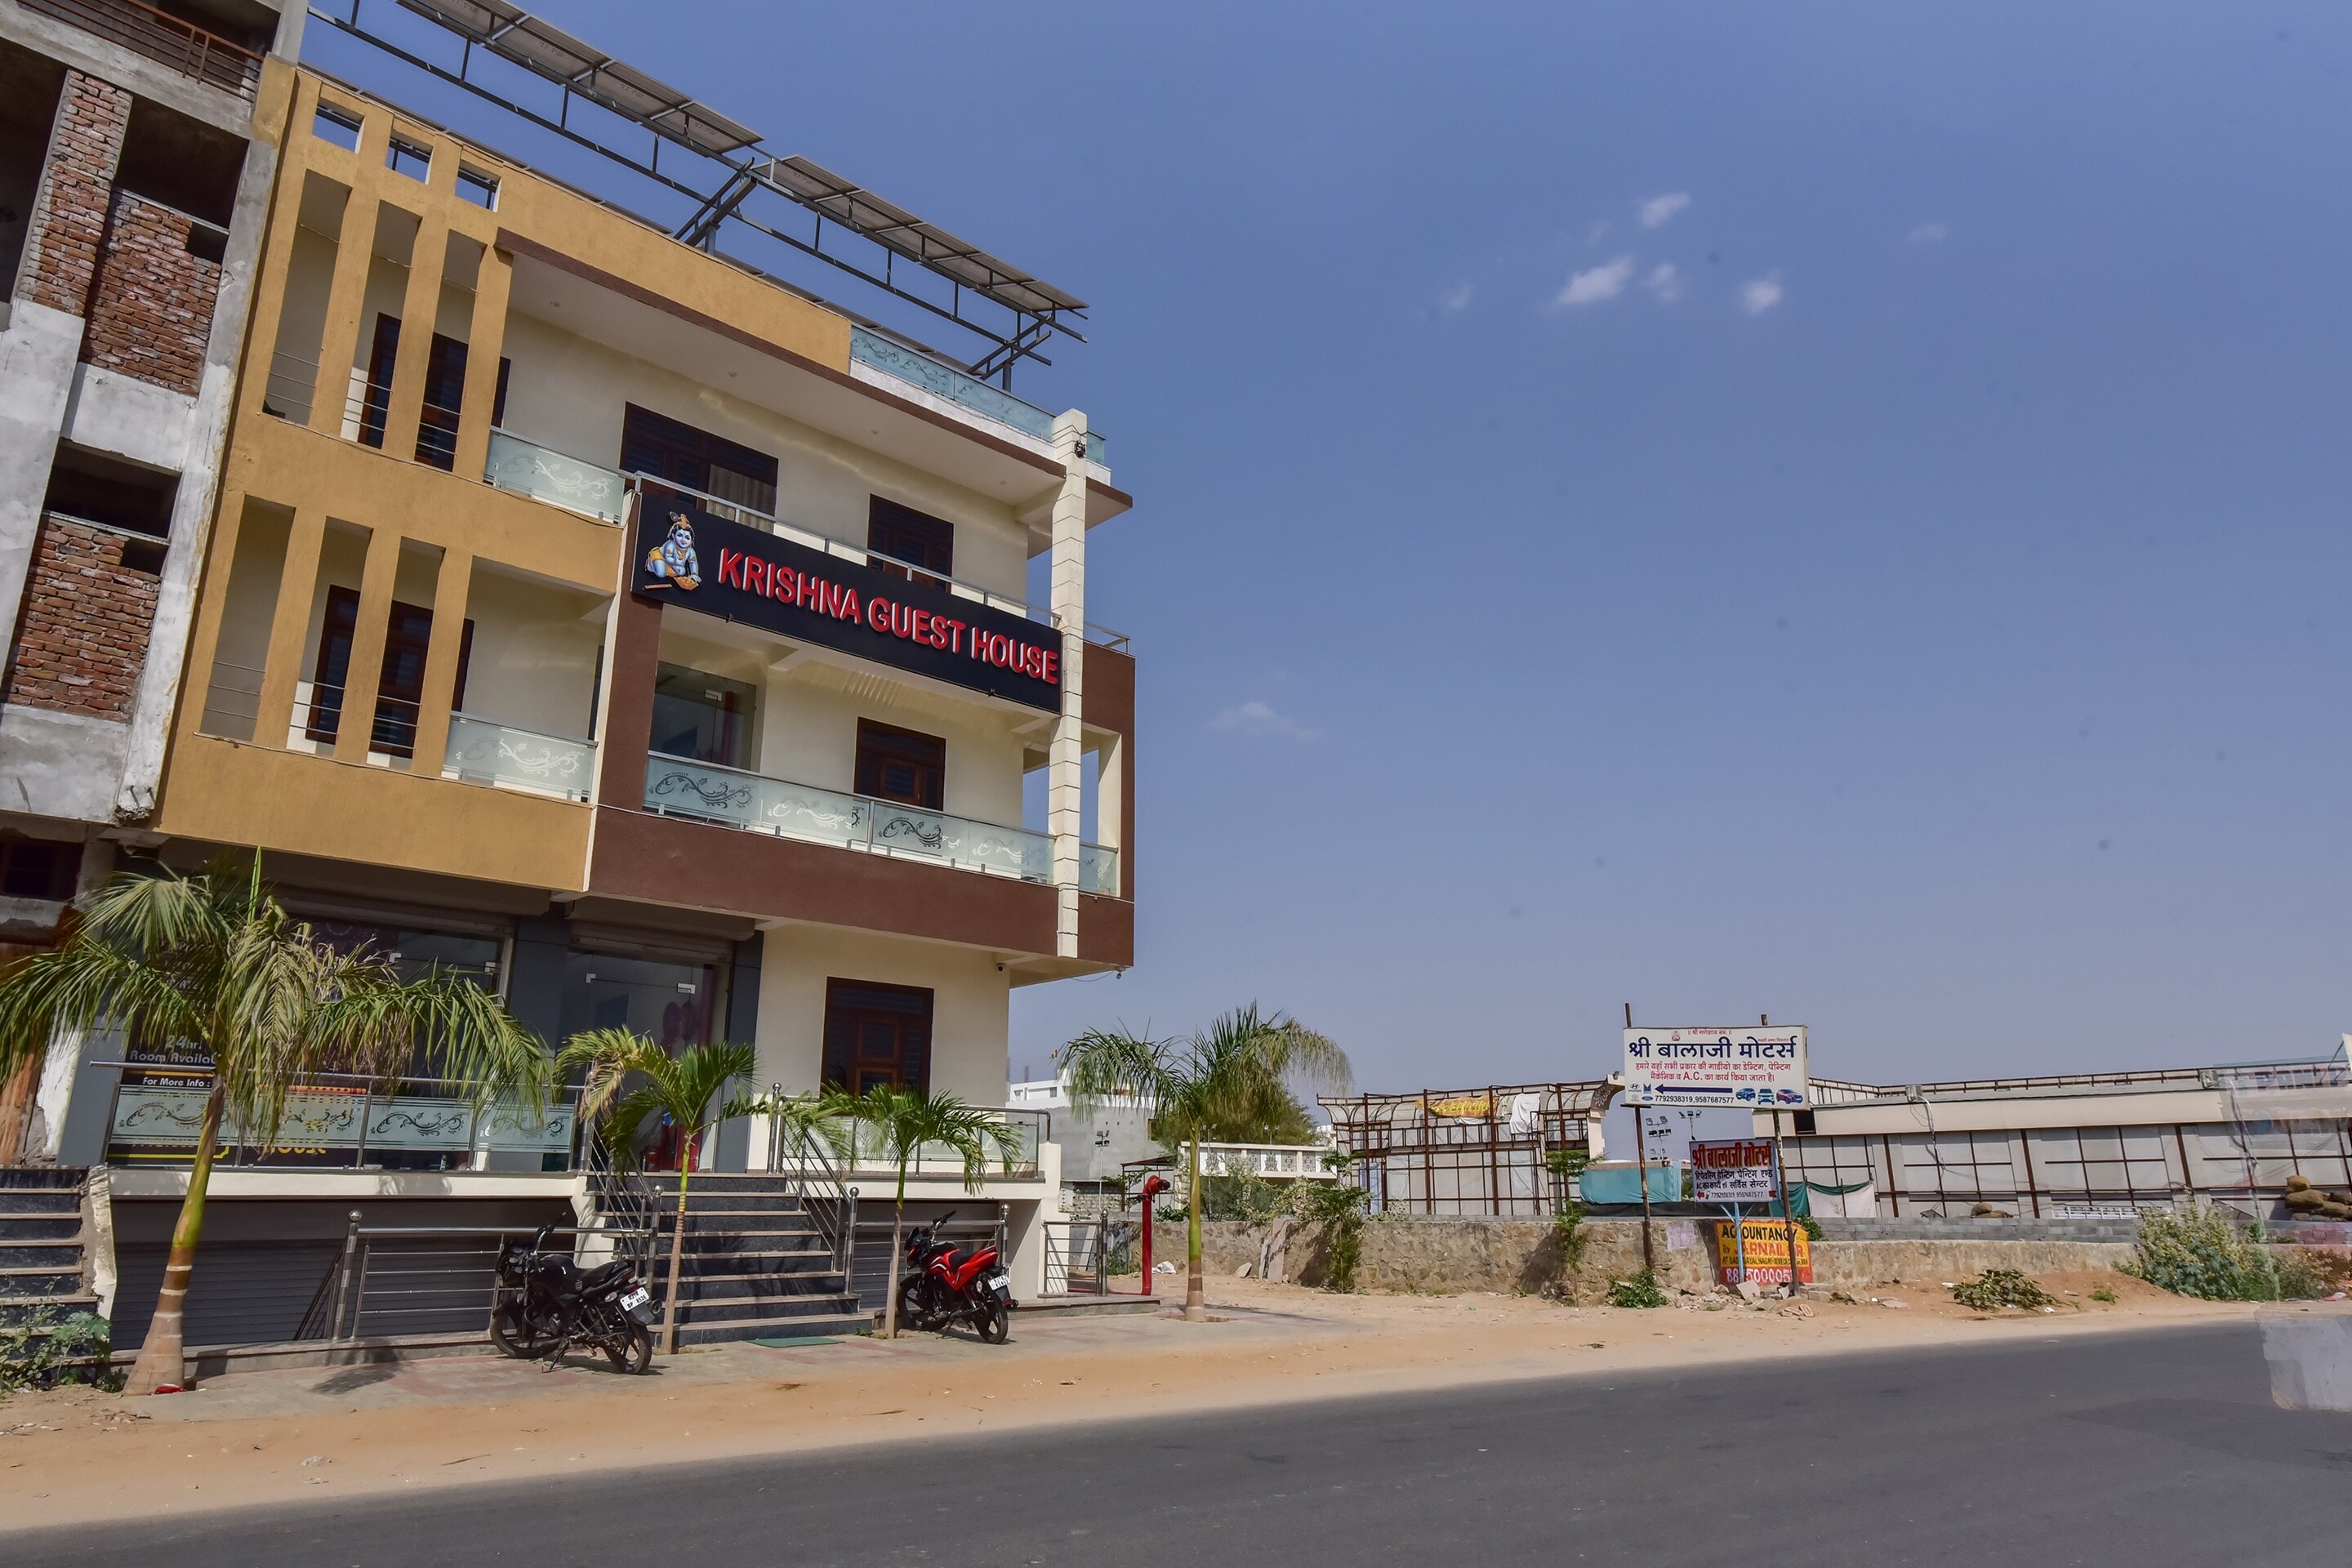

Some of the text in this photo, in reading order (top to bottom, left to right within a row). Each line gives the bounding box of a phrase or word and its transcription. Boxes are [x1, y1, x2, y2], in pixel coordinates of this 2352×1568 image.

[719, 548, 1060, 685] KRISHNA GUEST HOUSE
[1628, 1036, 1798, 1059] श्री बालाजी मोटर्स
[129, 1049, 166, 1062] Room
[1635, 1060, 1650, 1071] हमारे
[1664, 1060, 1678, 1070] सभी
[1680, 1062, 1696, 1071] प्रकार
[1698, 1060, 1707, 1070] की
[1768, 1061, 1792, 1071] पेन्टिंग
[142, 1076, 158, 1085] For
[159, 1077, 185, 1086] More
[186, 1078, 206, 1088] Info
[1650, 1071, 1675, 1080] मैकेनिक
[1683, 1071, 1703, 1080] A.C.
[1715, 1071, 1730, 1081] कार्य
[1731, 1071, 1748, 1081] किया
[1691, 1141, 1772, 1169] श्री बालाजी मोटर्स
[1730, 1178, 1747, 1189] सर्विस
[1749, 1178, 1768, 1189] सेन्टर
[1722, 1225, 1798, 1242] ACOUNTANCY
[1722, 1245, 1731, 1254] By
[1734, 1242, 1786, 1256] ARNAIL
